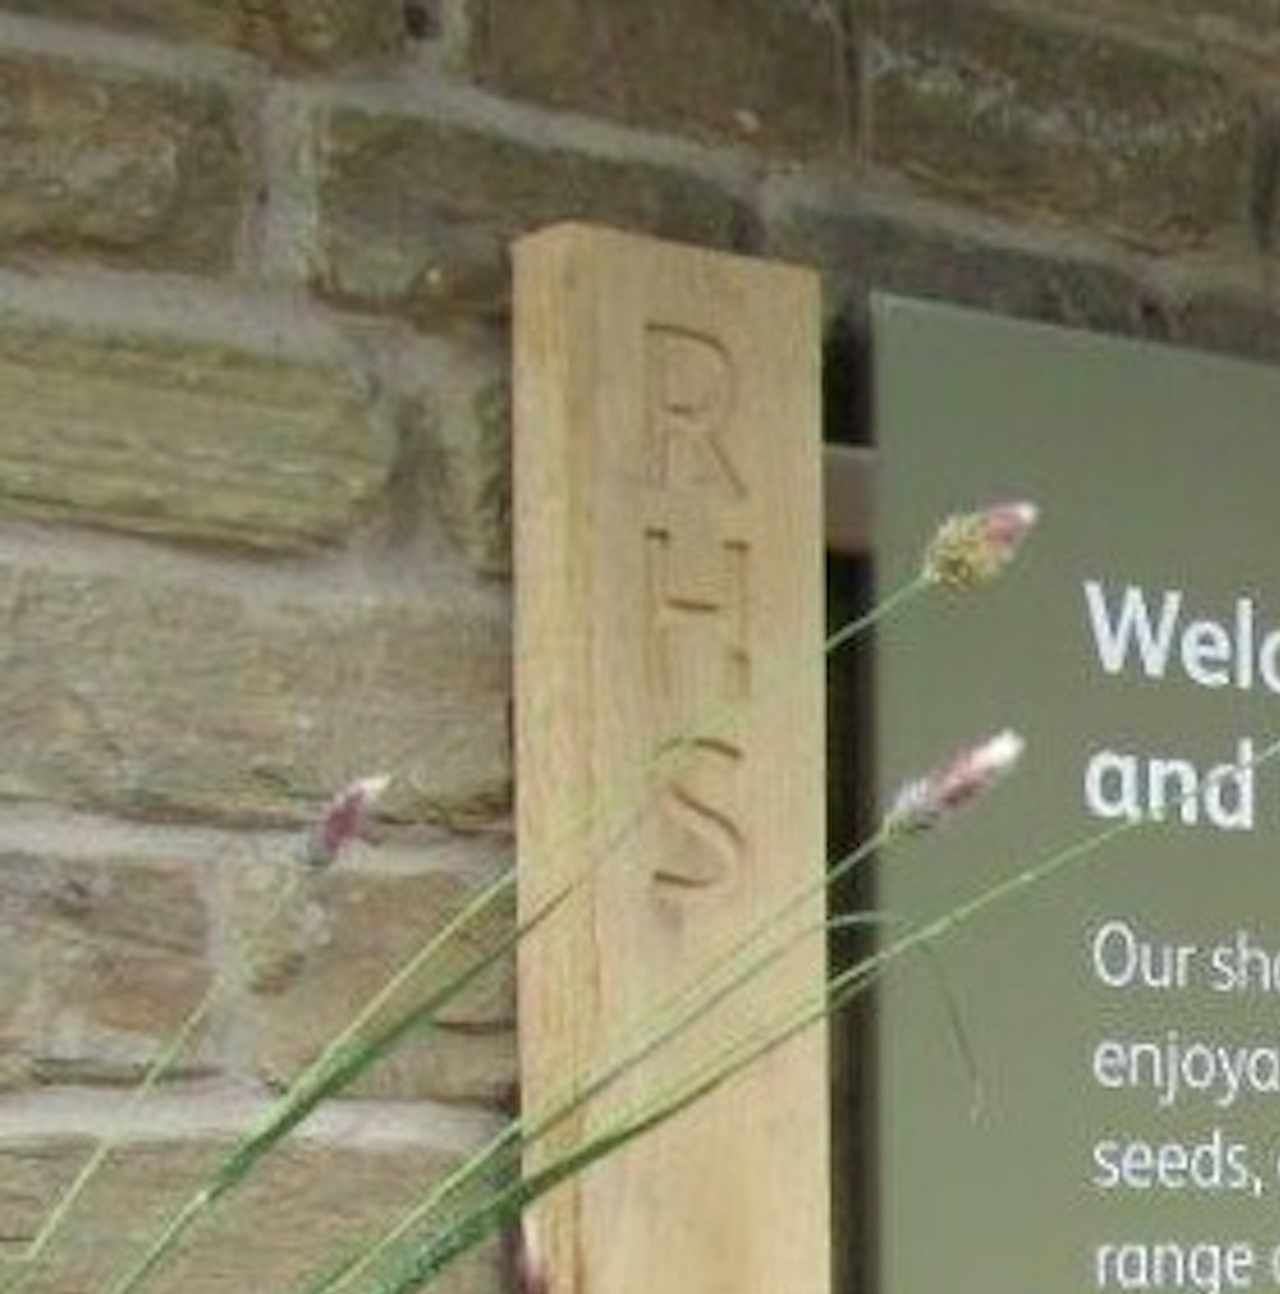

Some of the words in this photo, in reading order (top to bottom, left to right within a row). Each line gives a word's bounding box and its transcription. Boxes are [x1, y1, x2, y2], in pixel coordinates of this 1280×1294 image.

[645, 321, 750, 890] RHS
[1084, 737, 1254, 831] and
[1092, 921, 1199, 990] Our
[1093, 1131, 1262, 1198] seeds,
